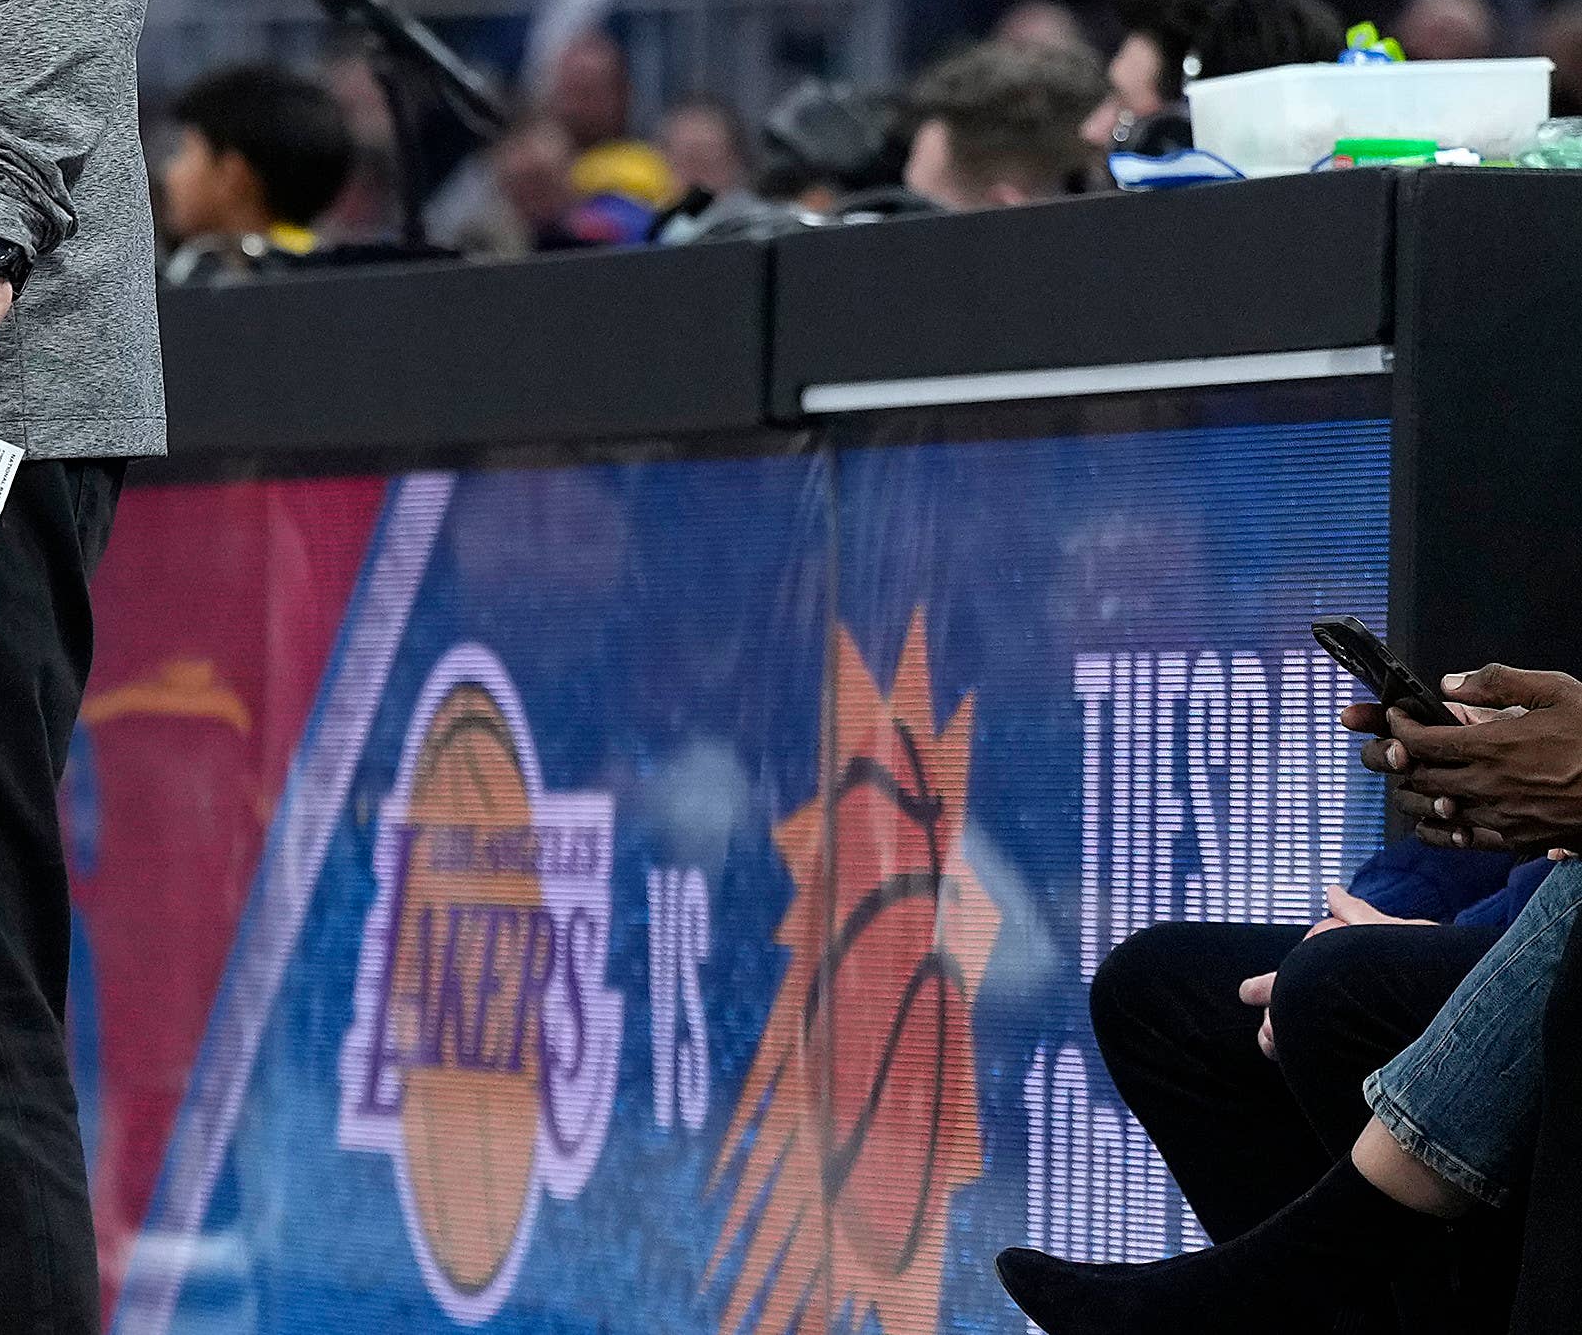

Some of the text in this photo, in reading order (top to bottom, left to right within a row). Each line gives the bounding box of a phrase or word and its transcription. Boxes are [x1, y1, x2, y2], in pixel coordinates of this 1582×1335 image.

[1, 452, 15, 485] NATIONAL
[1073, 650, 1354, 984] TUESDAY
[356, 826, 599, 1158] LAKERS
[647, 867, 711, 1131] VS
